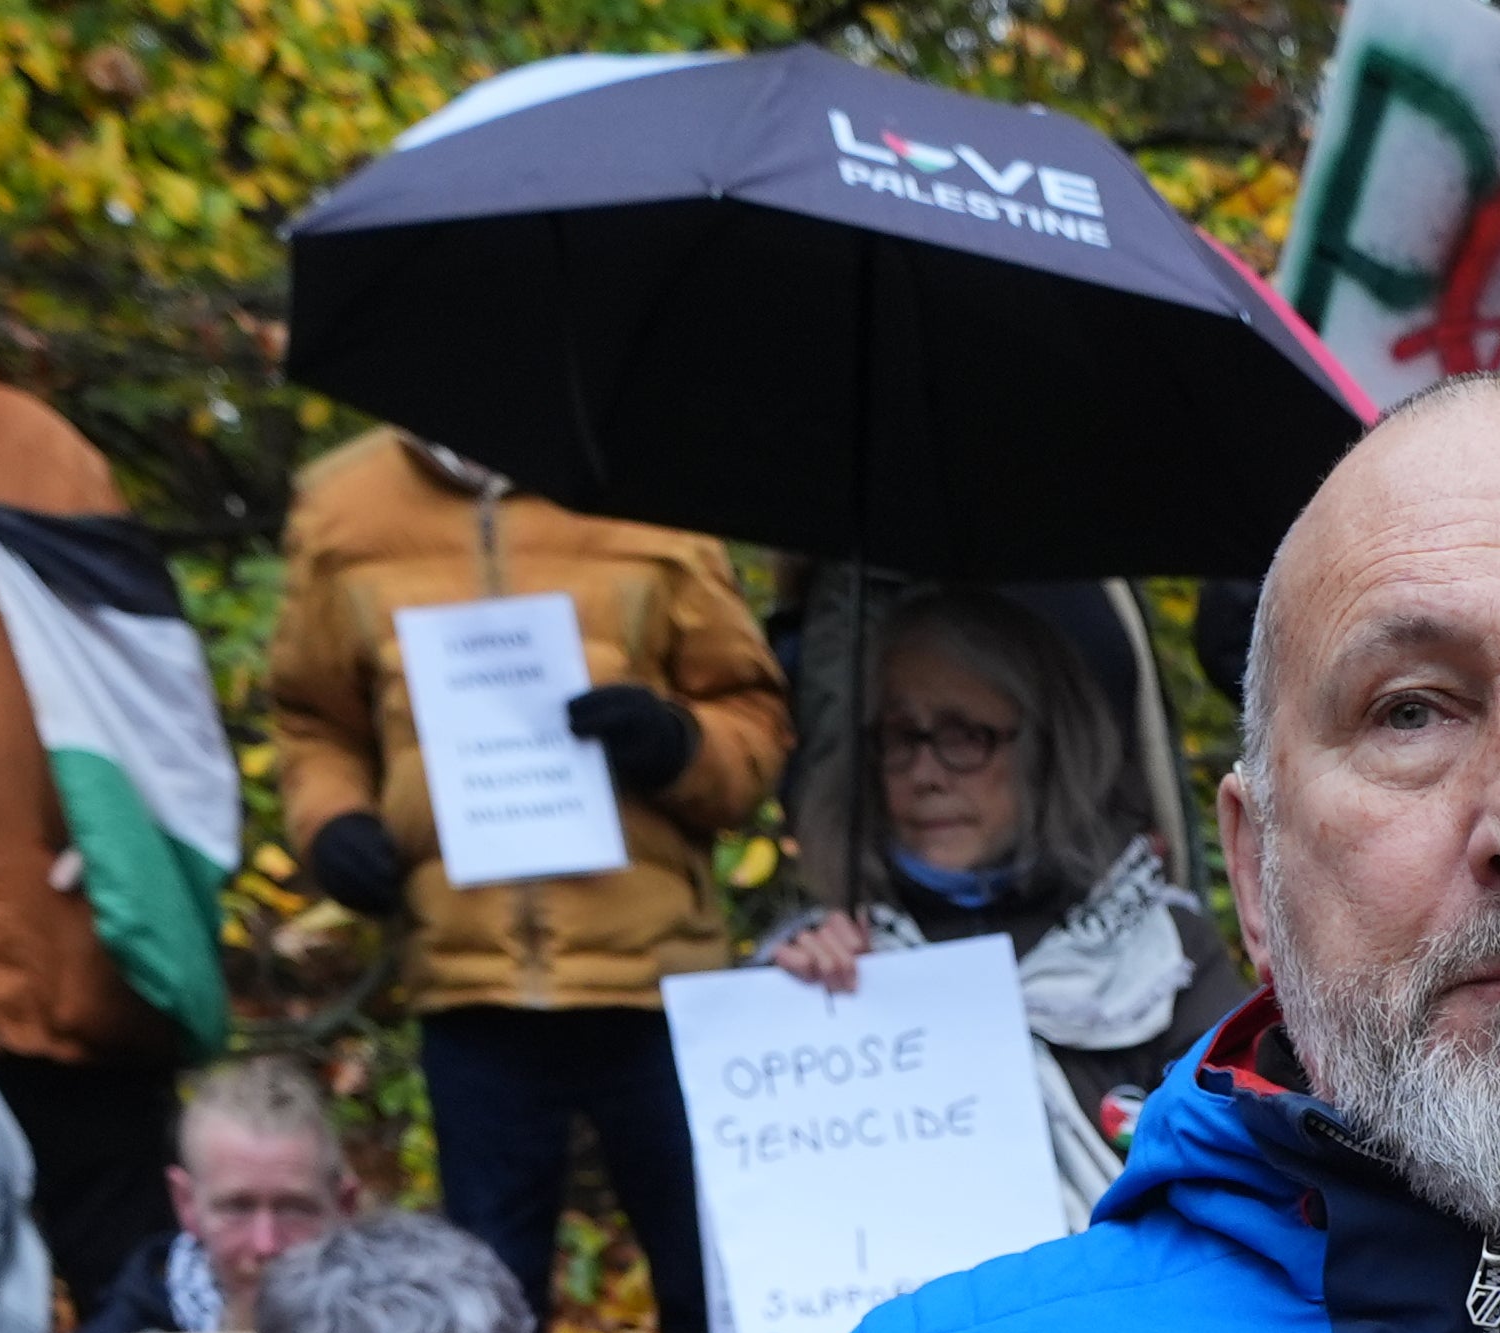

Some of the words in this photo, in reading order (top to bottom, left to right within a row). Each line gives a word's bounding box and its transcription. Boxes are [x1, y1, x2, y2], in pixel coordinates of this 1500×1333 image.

[837, 157, 1112, 250] PALESTINE
[722, 1026, 928, 1101] OPPOSE
[713, 1090, 980, 1169] GENOCIDE
[854, 1226, 869, 1274] I
